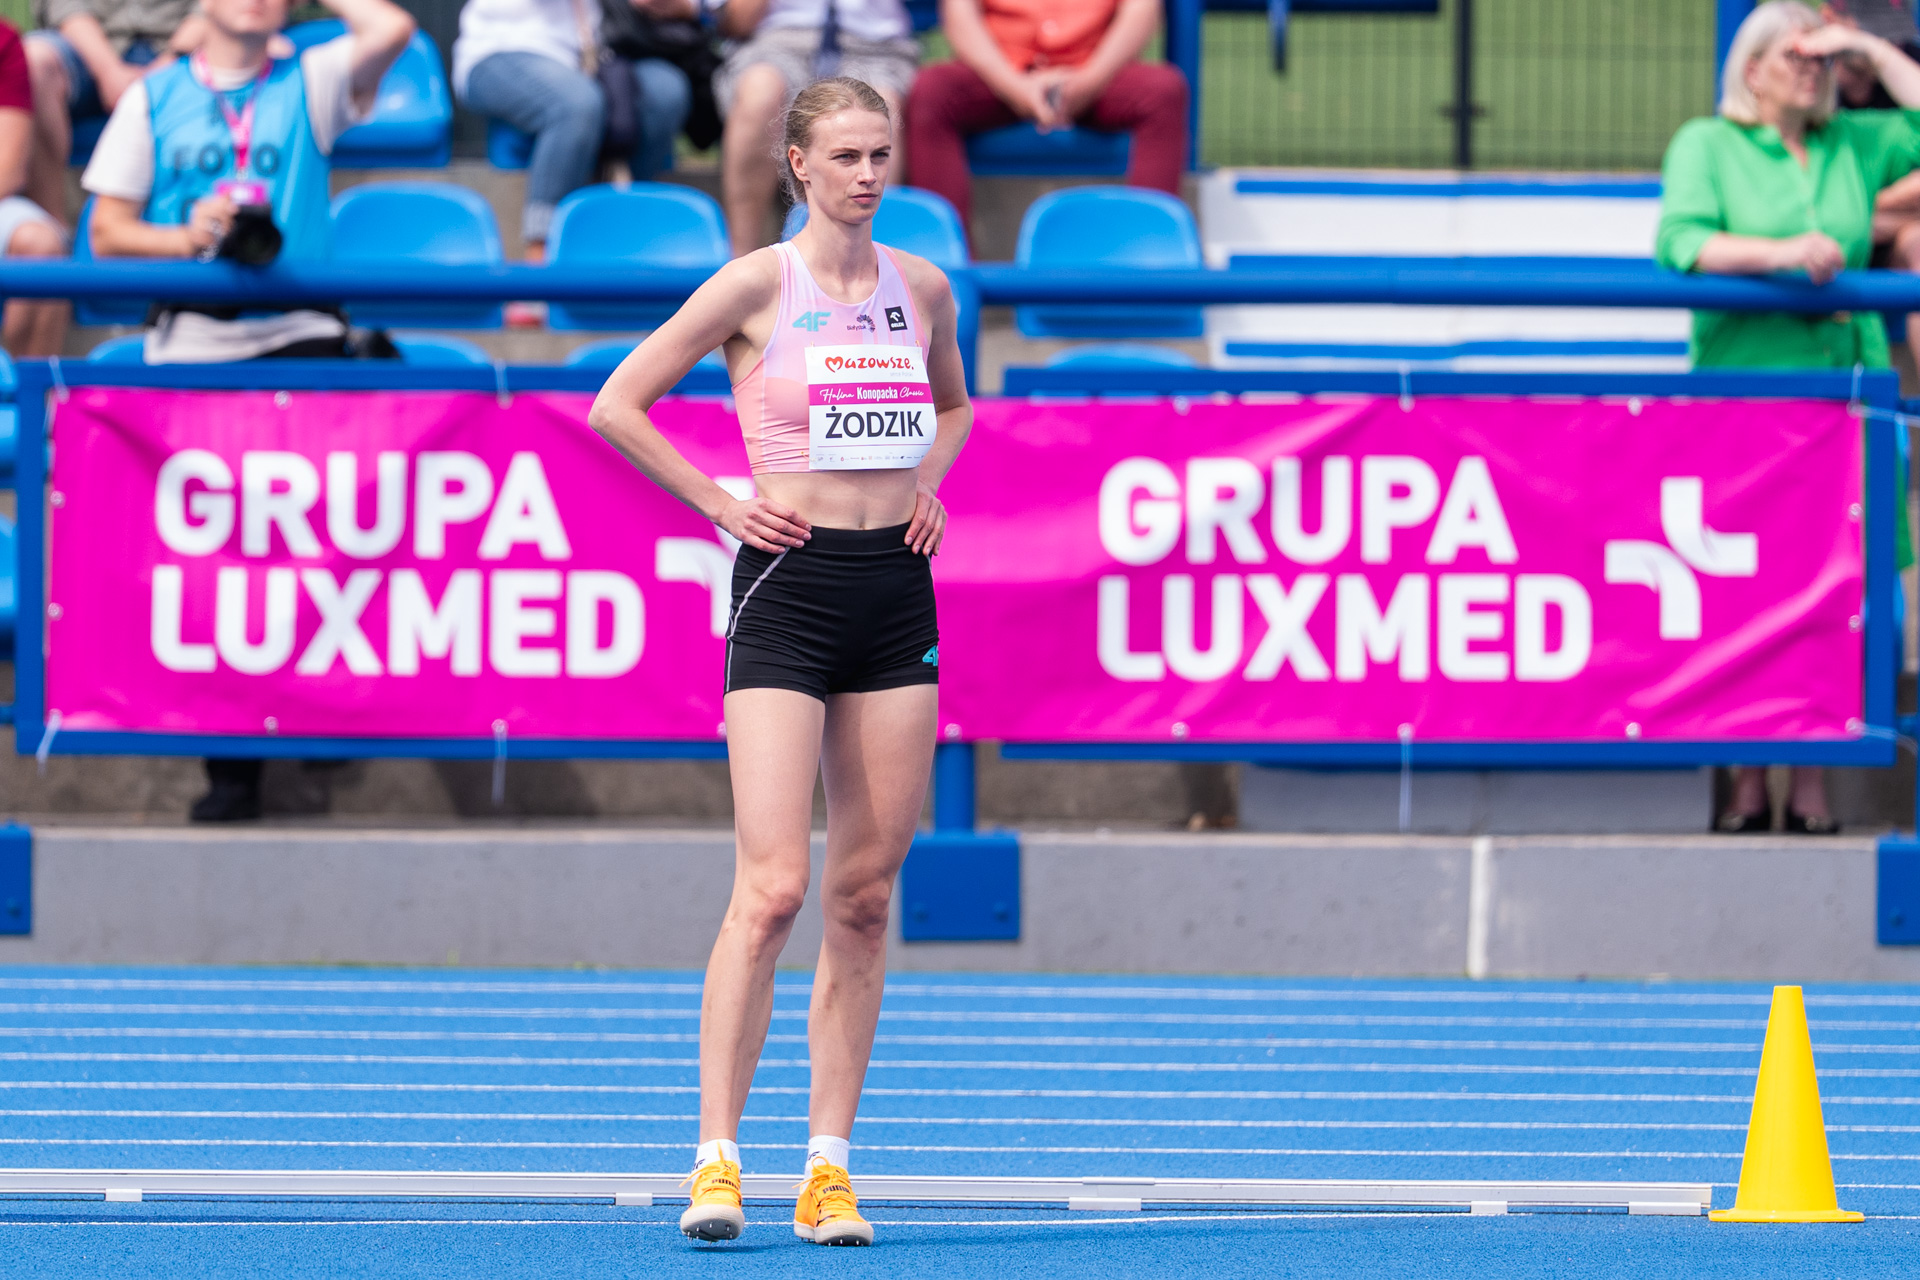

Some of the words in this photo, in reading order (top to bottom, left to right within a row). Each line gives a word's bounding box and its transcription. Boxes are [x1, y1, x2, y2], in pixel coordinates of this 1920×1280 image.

[172, 144, 281, 178] FOO
[792, 311, 832, 332] 4F
[819, 388, 854, 403] Halina
[856, 386, 898, 402] Konopacka
[899, 386, 924, 398] Classic
[825, 405, 924, 439] ŻODZIK
[155, 448, 573, 560] GRUPA
[1098, 454, 1519, 566] GRUPA
[150, 564, 646, 678] LUXMED
[1096, 572, 1594, 683] LUXMED
[922, 645, 939, 667] 4
